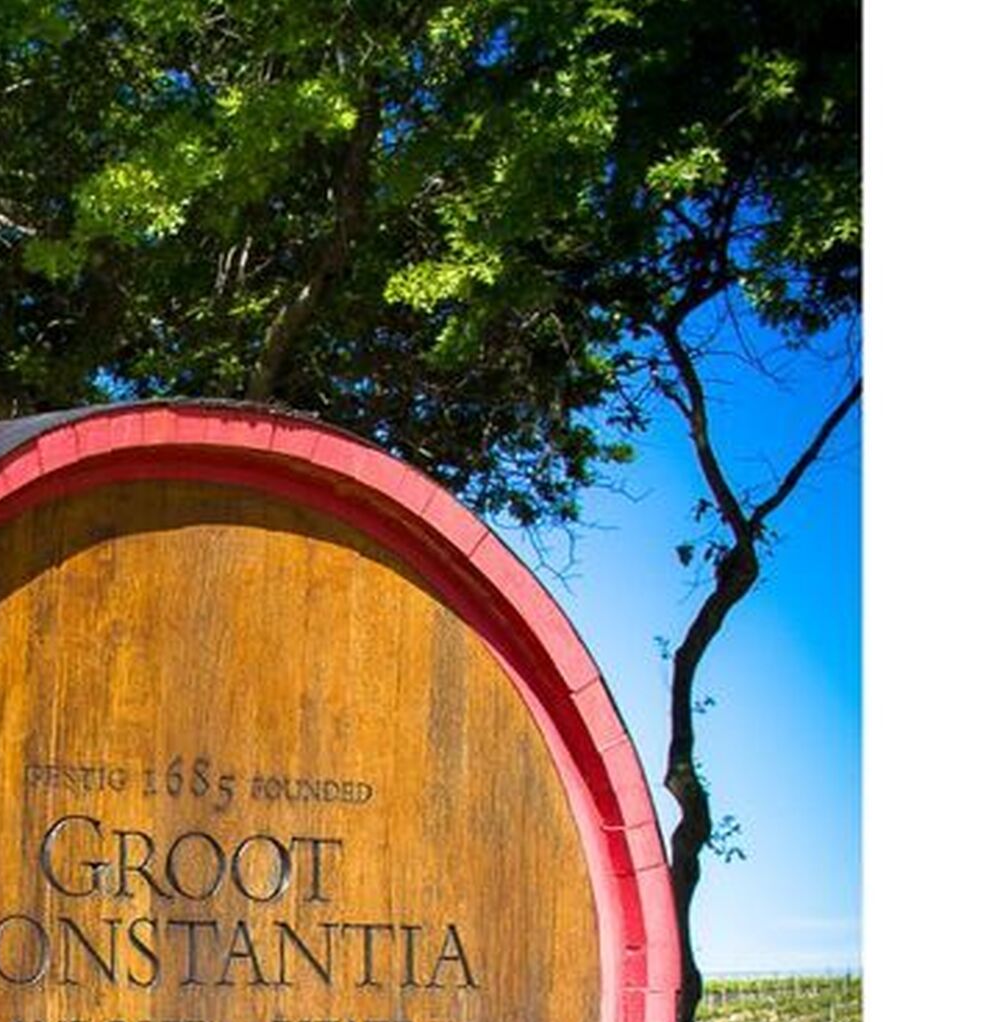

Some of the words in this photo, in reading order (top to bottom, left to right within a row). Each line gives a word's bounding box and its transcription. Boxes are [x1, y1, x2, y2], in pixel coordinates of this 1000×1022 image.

[142, 754, 236, 812] 1685
[250, 775, 373, 804] FOUNDED
[40, 814, 343, 902] GROOT
